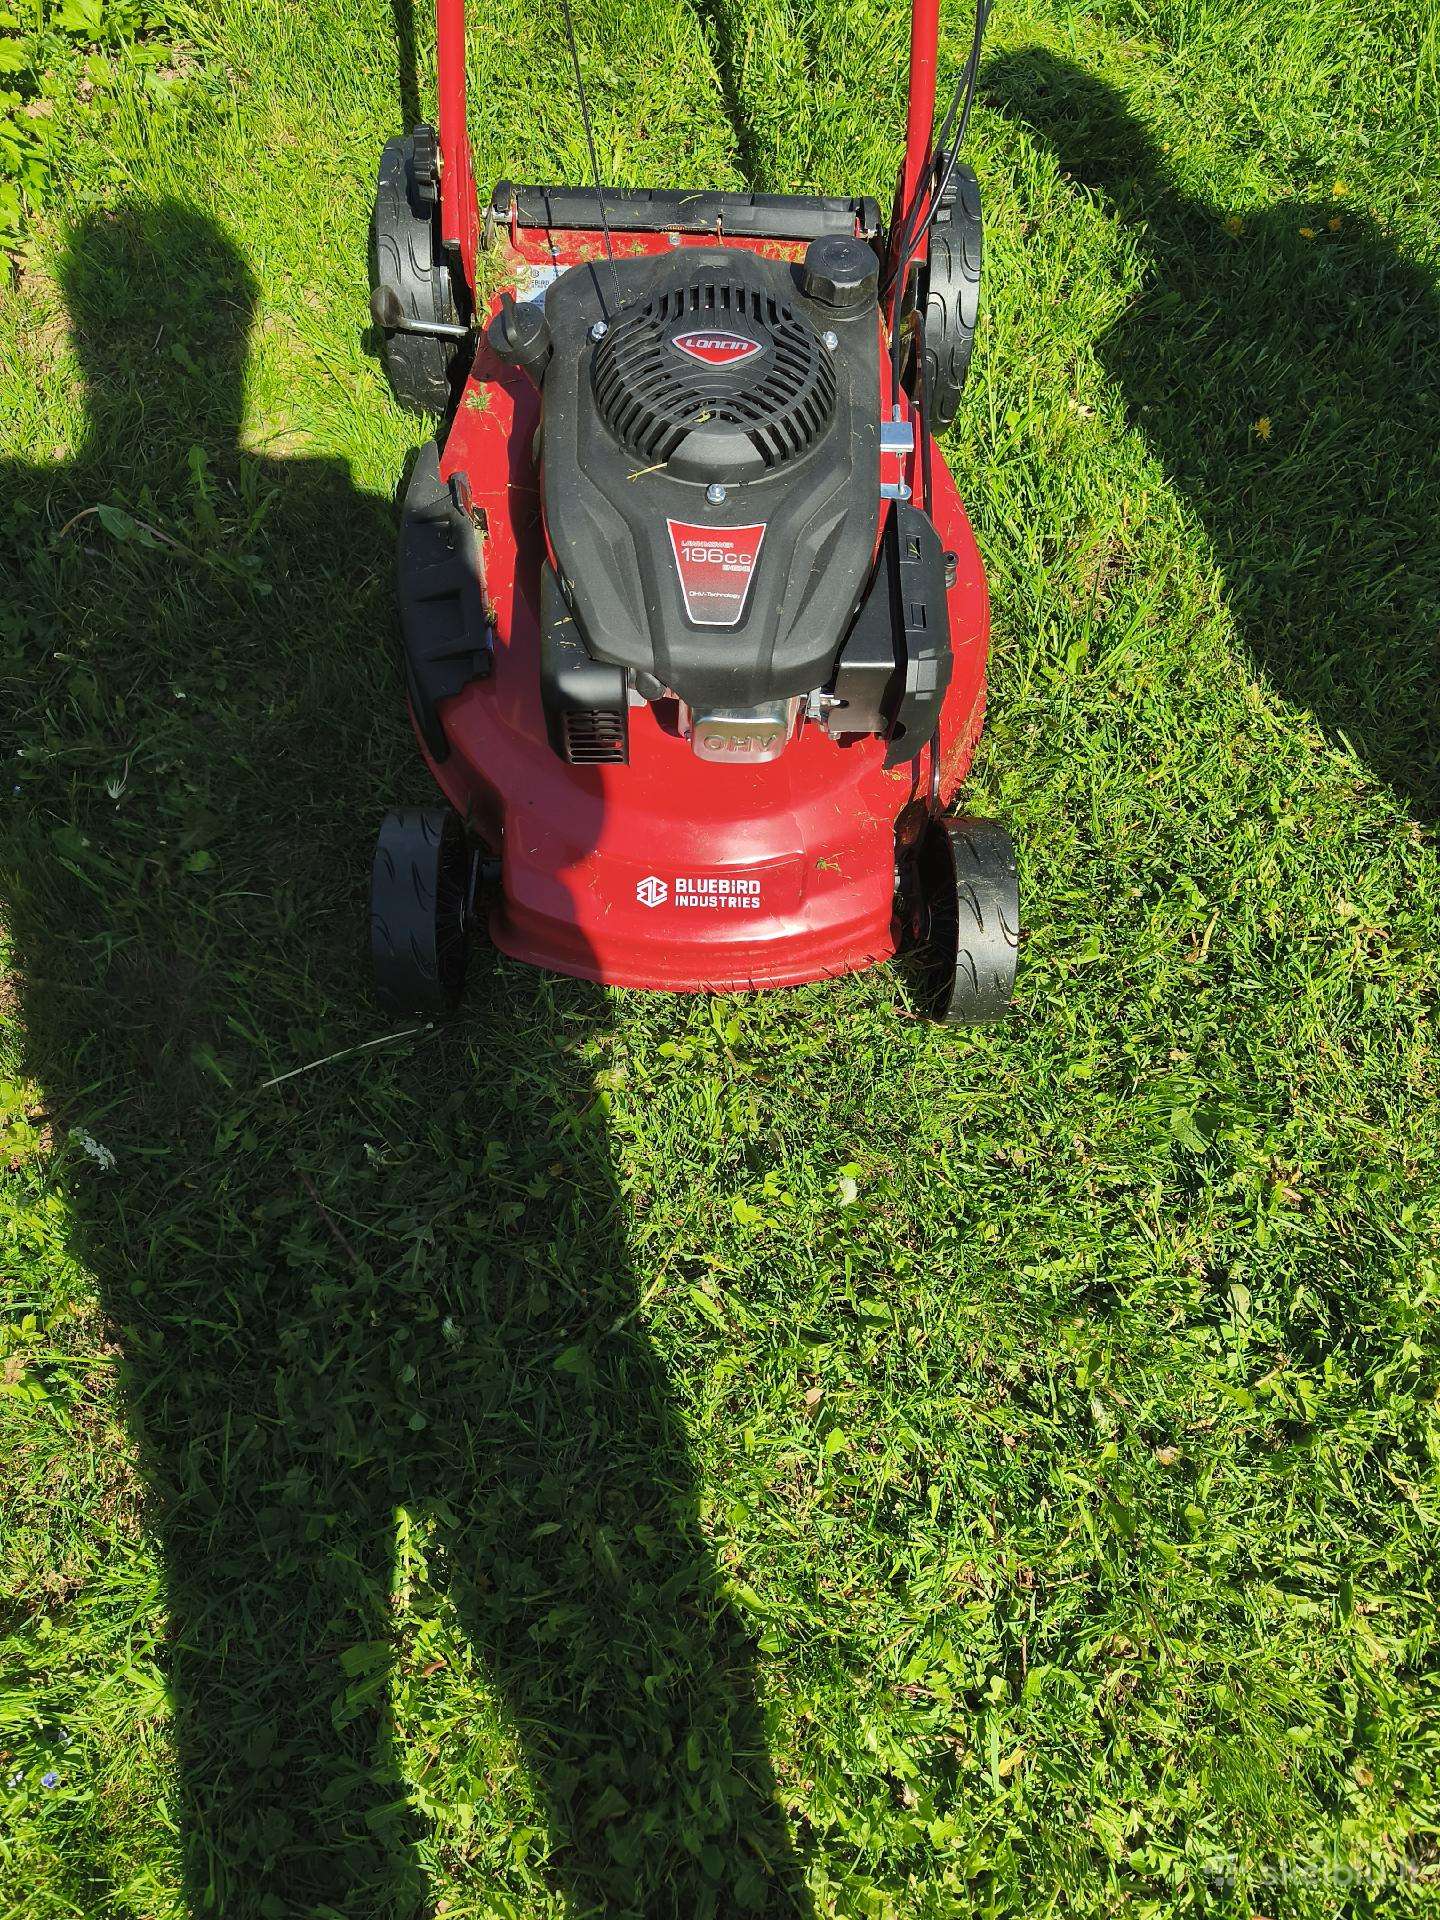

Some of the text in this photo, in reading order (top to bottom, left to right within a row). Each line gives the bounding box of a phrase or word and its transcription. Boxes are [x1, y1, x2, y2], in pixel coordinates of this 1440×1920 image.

[685, 338, 749, 350] LONCIN
[681, 547, 752, 565] 196cc
[703, 733, 777, 753] OHV
[675, 878, 761, 895] BLUEBIRD
[675, 895, 761, 909] INDUSTRIES
